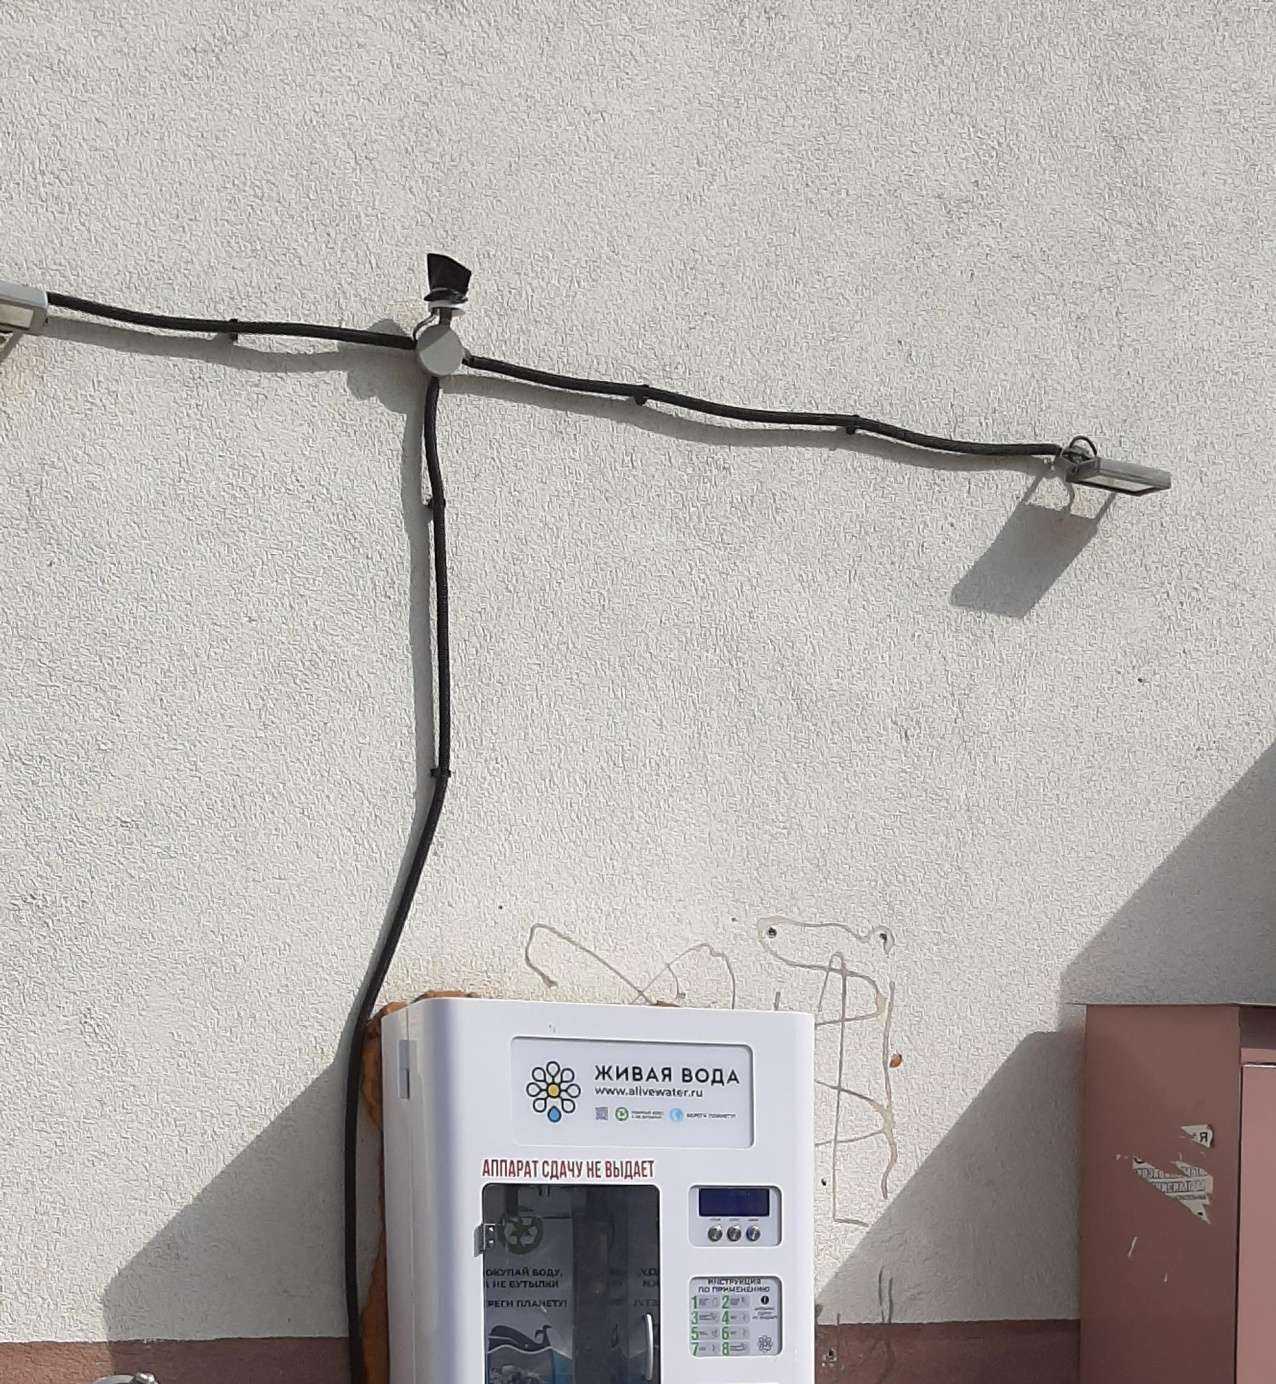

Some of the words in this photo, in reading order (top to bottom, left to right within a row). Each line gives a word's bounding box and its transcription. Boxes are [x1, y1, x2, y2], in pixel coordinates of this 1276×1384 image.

[594, 1065, 672, 1082] ЖИВАЯ
[681, 1067, 740, 1086] ВОДА
[594, 1086, 703, 1098] www.alivewater.ru
[482, 1159, 539, 1178] АППАРАТ
[541, 1160, 583, 1180] СДАЧУ
[586, 1161, 601, 1178] НЕ
[604, 1160, 655, 1180] ВЫДАЕТ
[485, 1267, 529, 1277] ОКУПАЙ
[487, 1300, 514, 1308] РЕГИ
[691, 1295, 699, 1309] 1
[722, 1295, 730, 1309] 2
[691, 1311, 699, 1325] 3
[722, 1311, 730, 1325] 4
[691, 1326, 699, 1340] 5
[722, 1326, 730, 1340] 6
[691, 1342, 699, 1356] 7
[722, 1342, 730, 1356] 8
